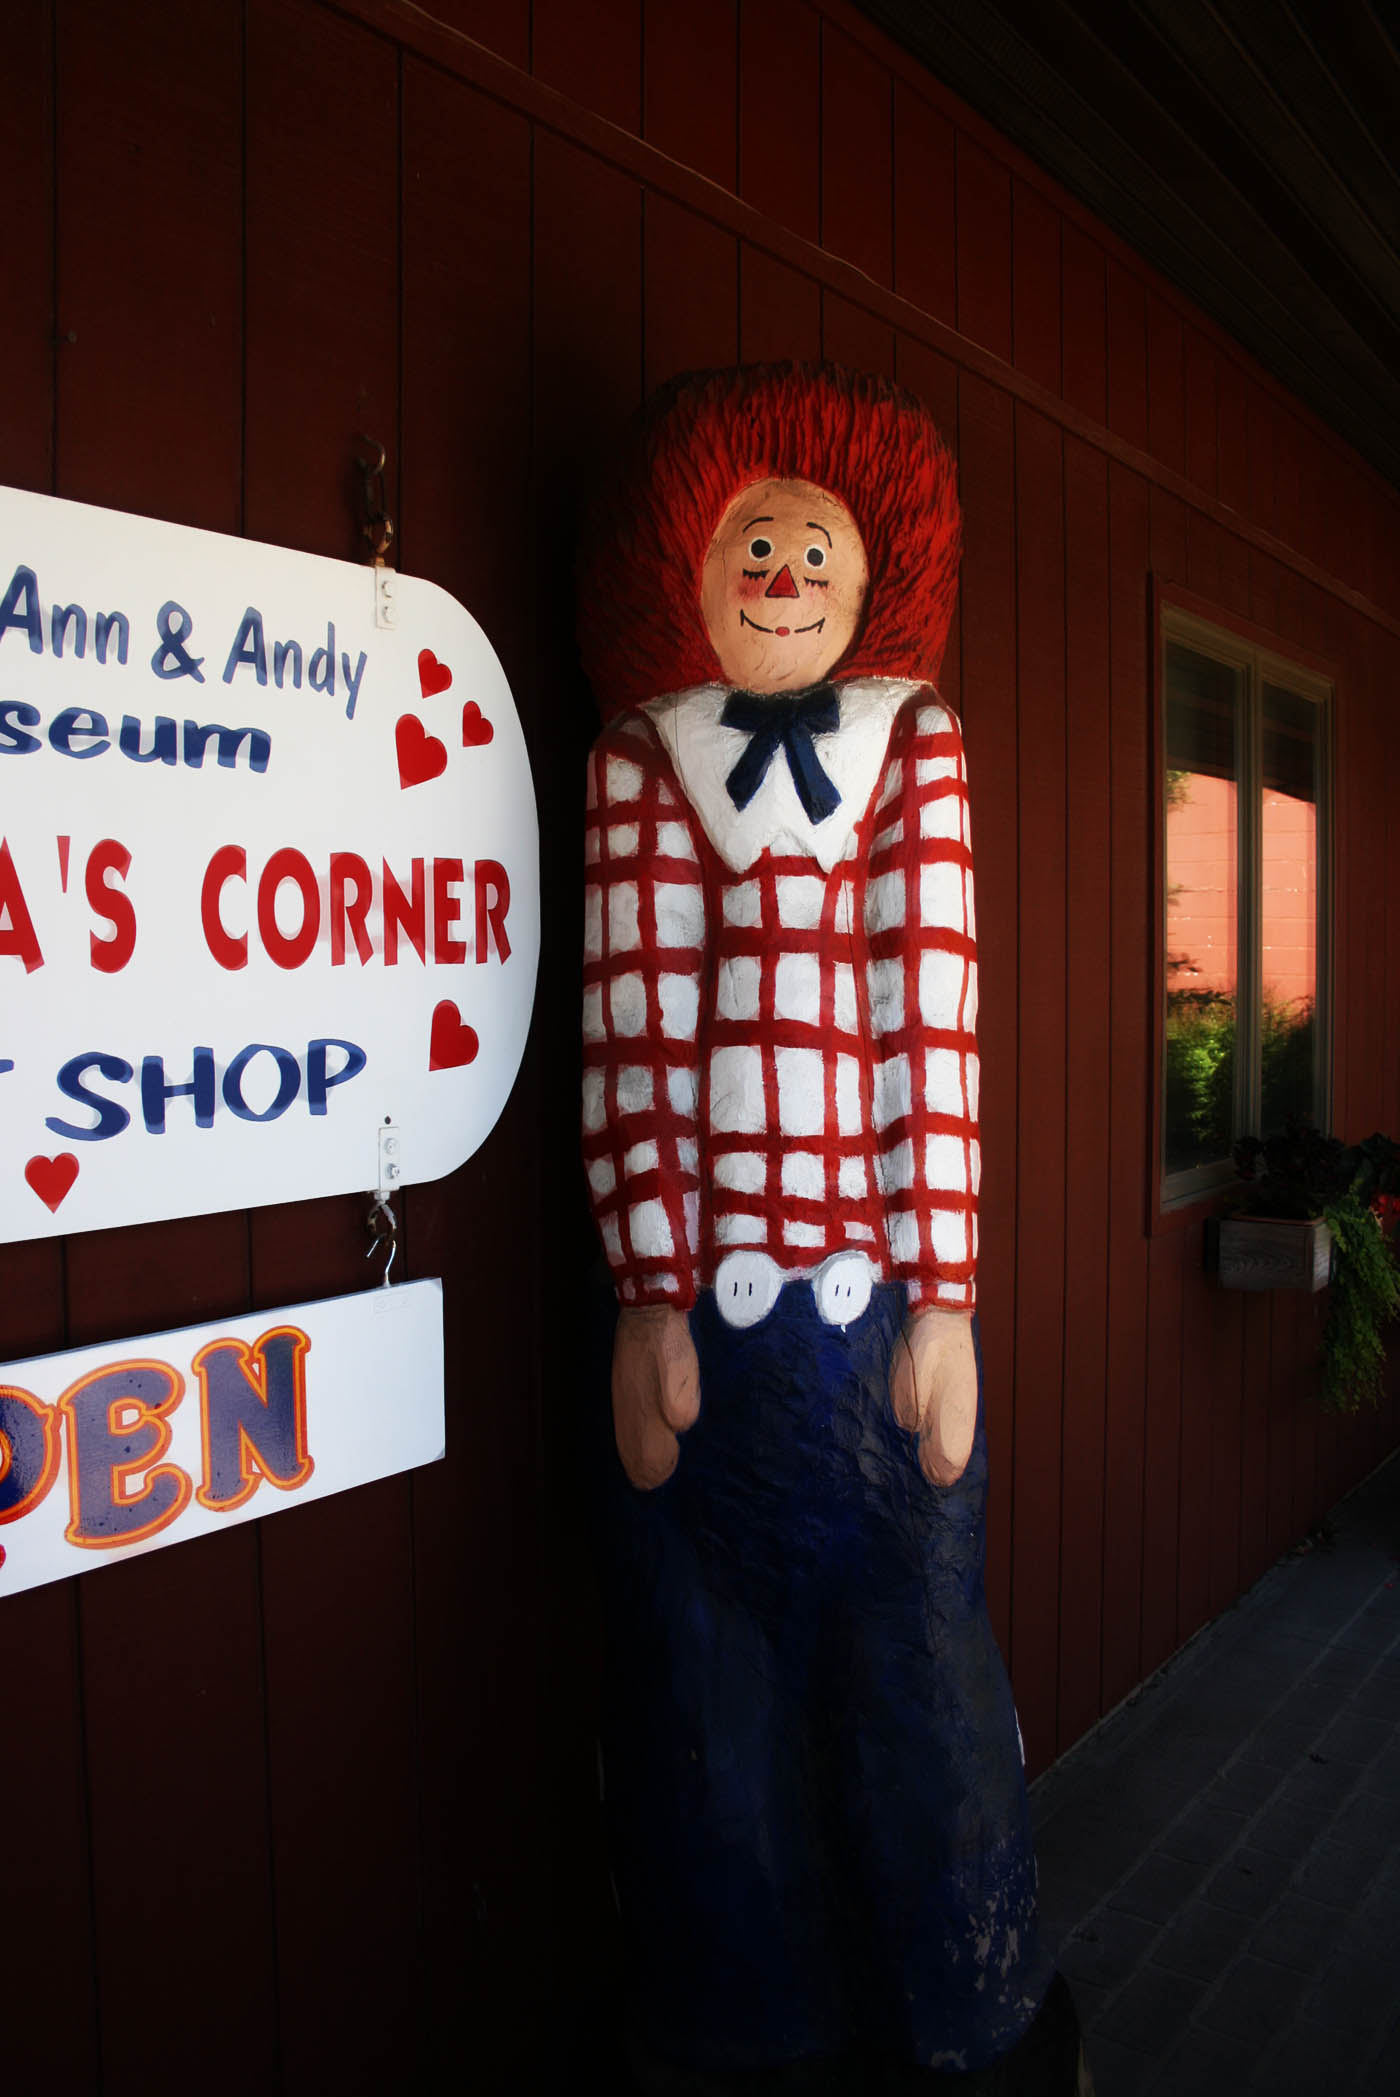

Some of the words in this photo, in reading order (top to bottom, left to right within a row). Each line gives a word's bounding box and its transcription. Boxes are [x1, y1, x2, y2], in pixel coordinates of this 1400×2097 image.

[0, 564, 130, 665] Ann
[151, 600, 205, 684] &
[222, 606, 367, 720] Andy
[0, 700, 272, 773] seum
[201, 844, 512, 971] CORNER
[45, 1038, 367, 1141] SHOP
